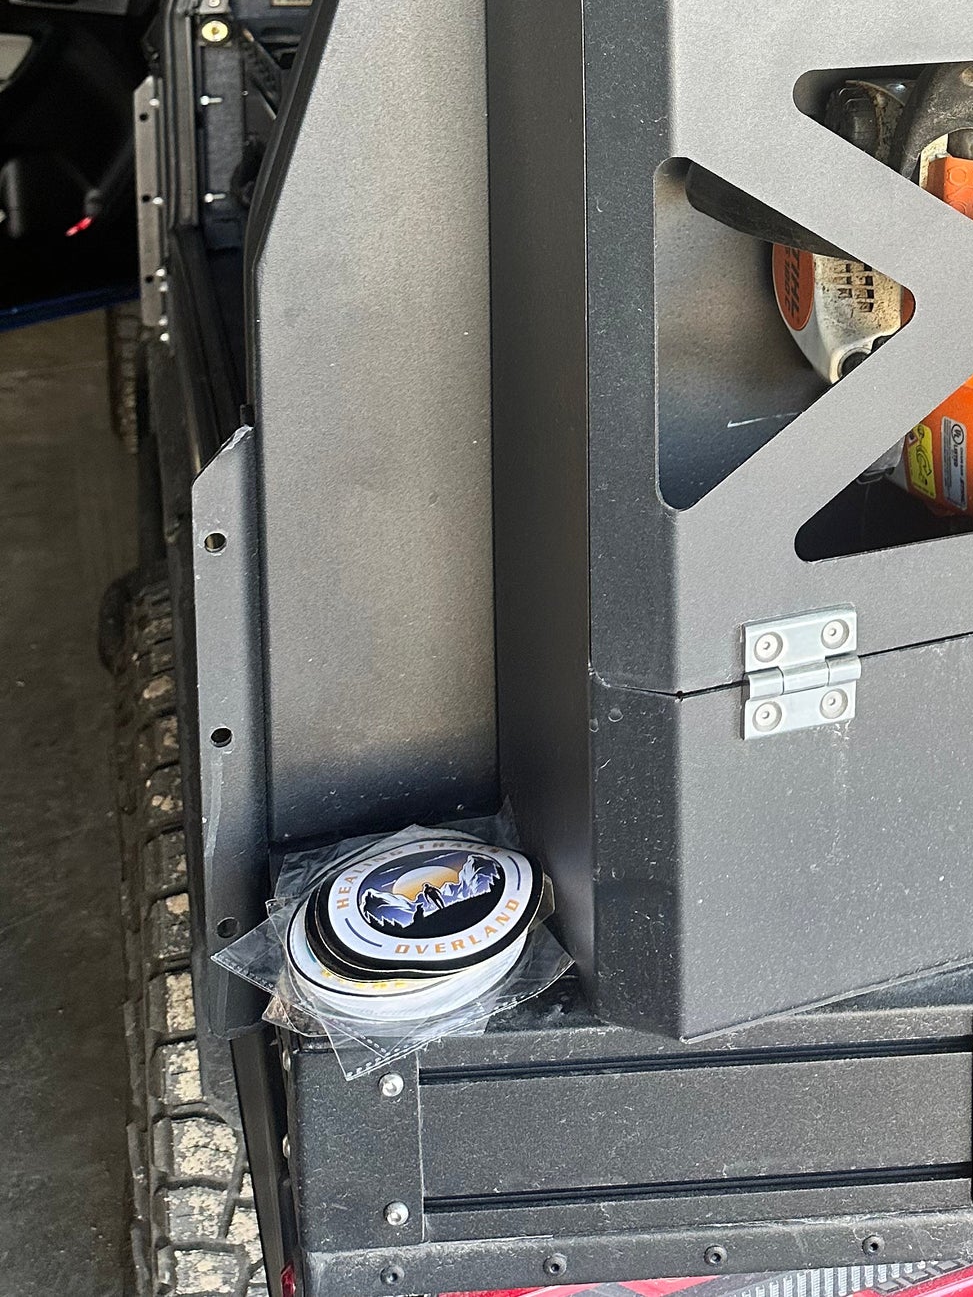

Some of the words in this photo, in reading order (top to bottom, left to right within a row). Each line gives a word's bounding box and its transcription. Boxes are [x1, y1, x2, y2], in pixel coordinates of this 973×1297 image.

[337, 849, 403, 910] HEALING
[417, 842, 502, 853] TRAILS
[394, 898, 520, 955] OVERLAND
